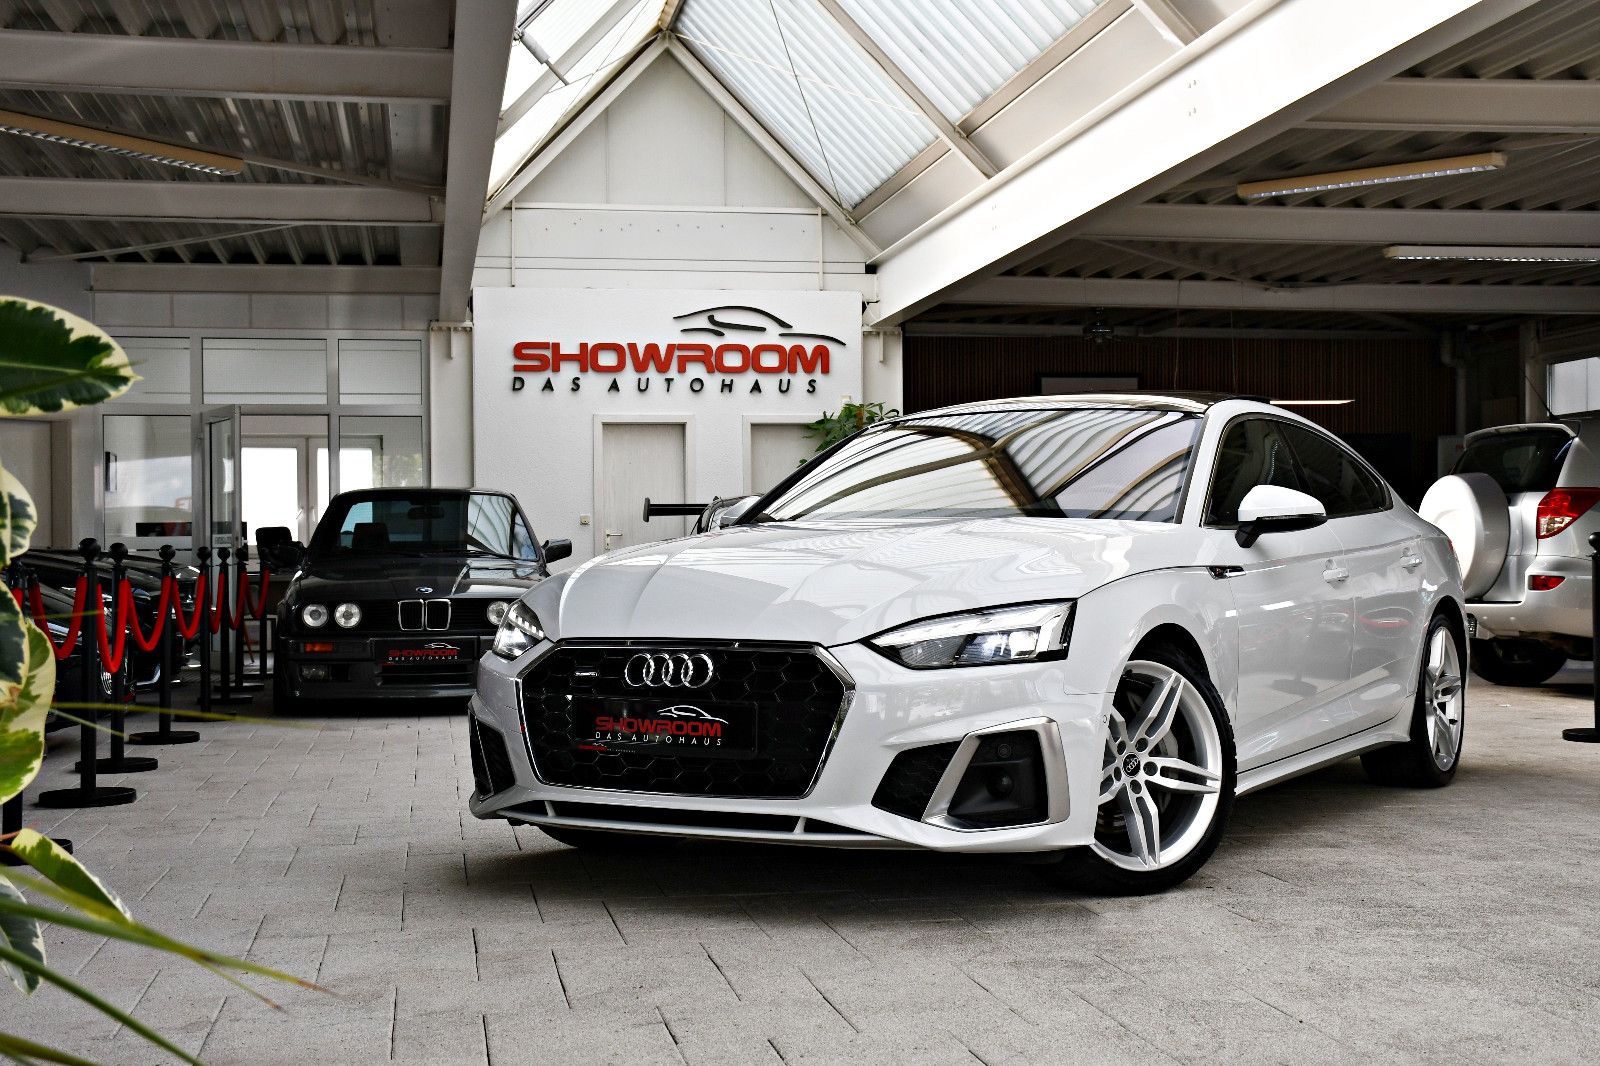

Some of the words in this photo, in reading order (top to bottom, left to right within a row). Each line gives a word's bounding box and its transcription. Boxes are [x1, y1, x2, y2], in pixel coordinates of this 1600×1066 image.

[513, 342, 830, 374] SHOWROOM
[512, 376, 581, 393] DAS
[607, 377, 818, 394] AUTOHAUS
[595, 716, 722, 737] SHOWROOM
[595, 731, 622, 741] DAS
[631, 734, 722, 746] AUTOHAUS
